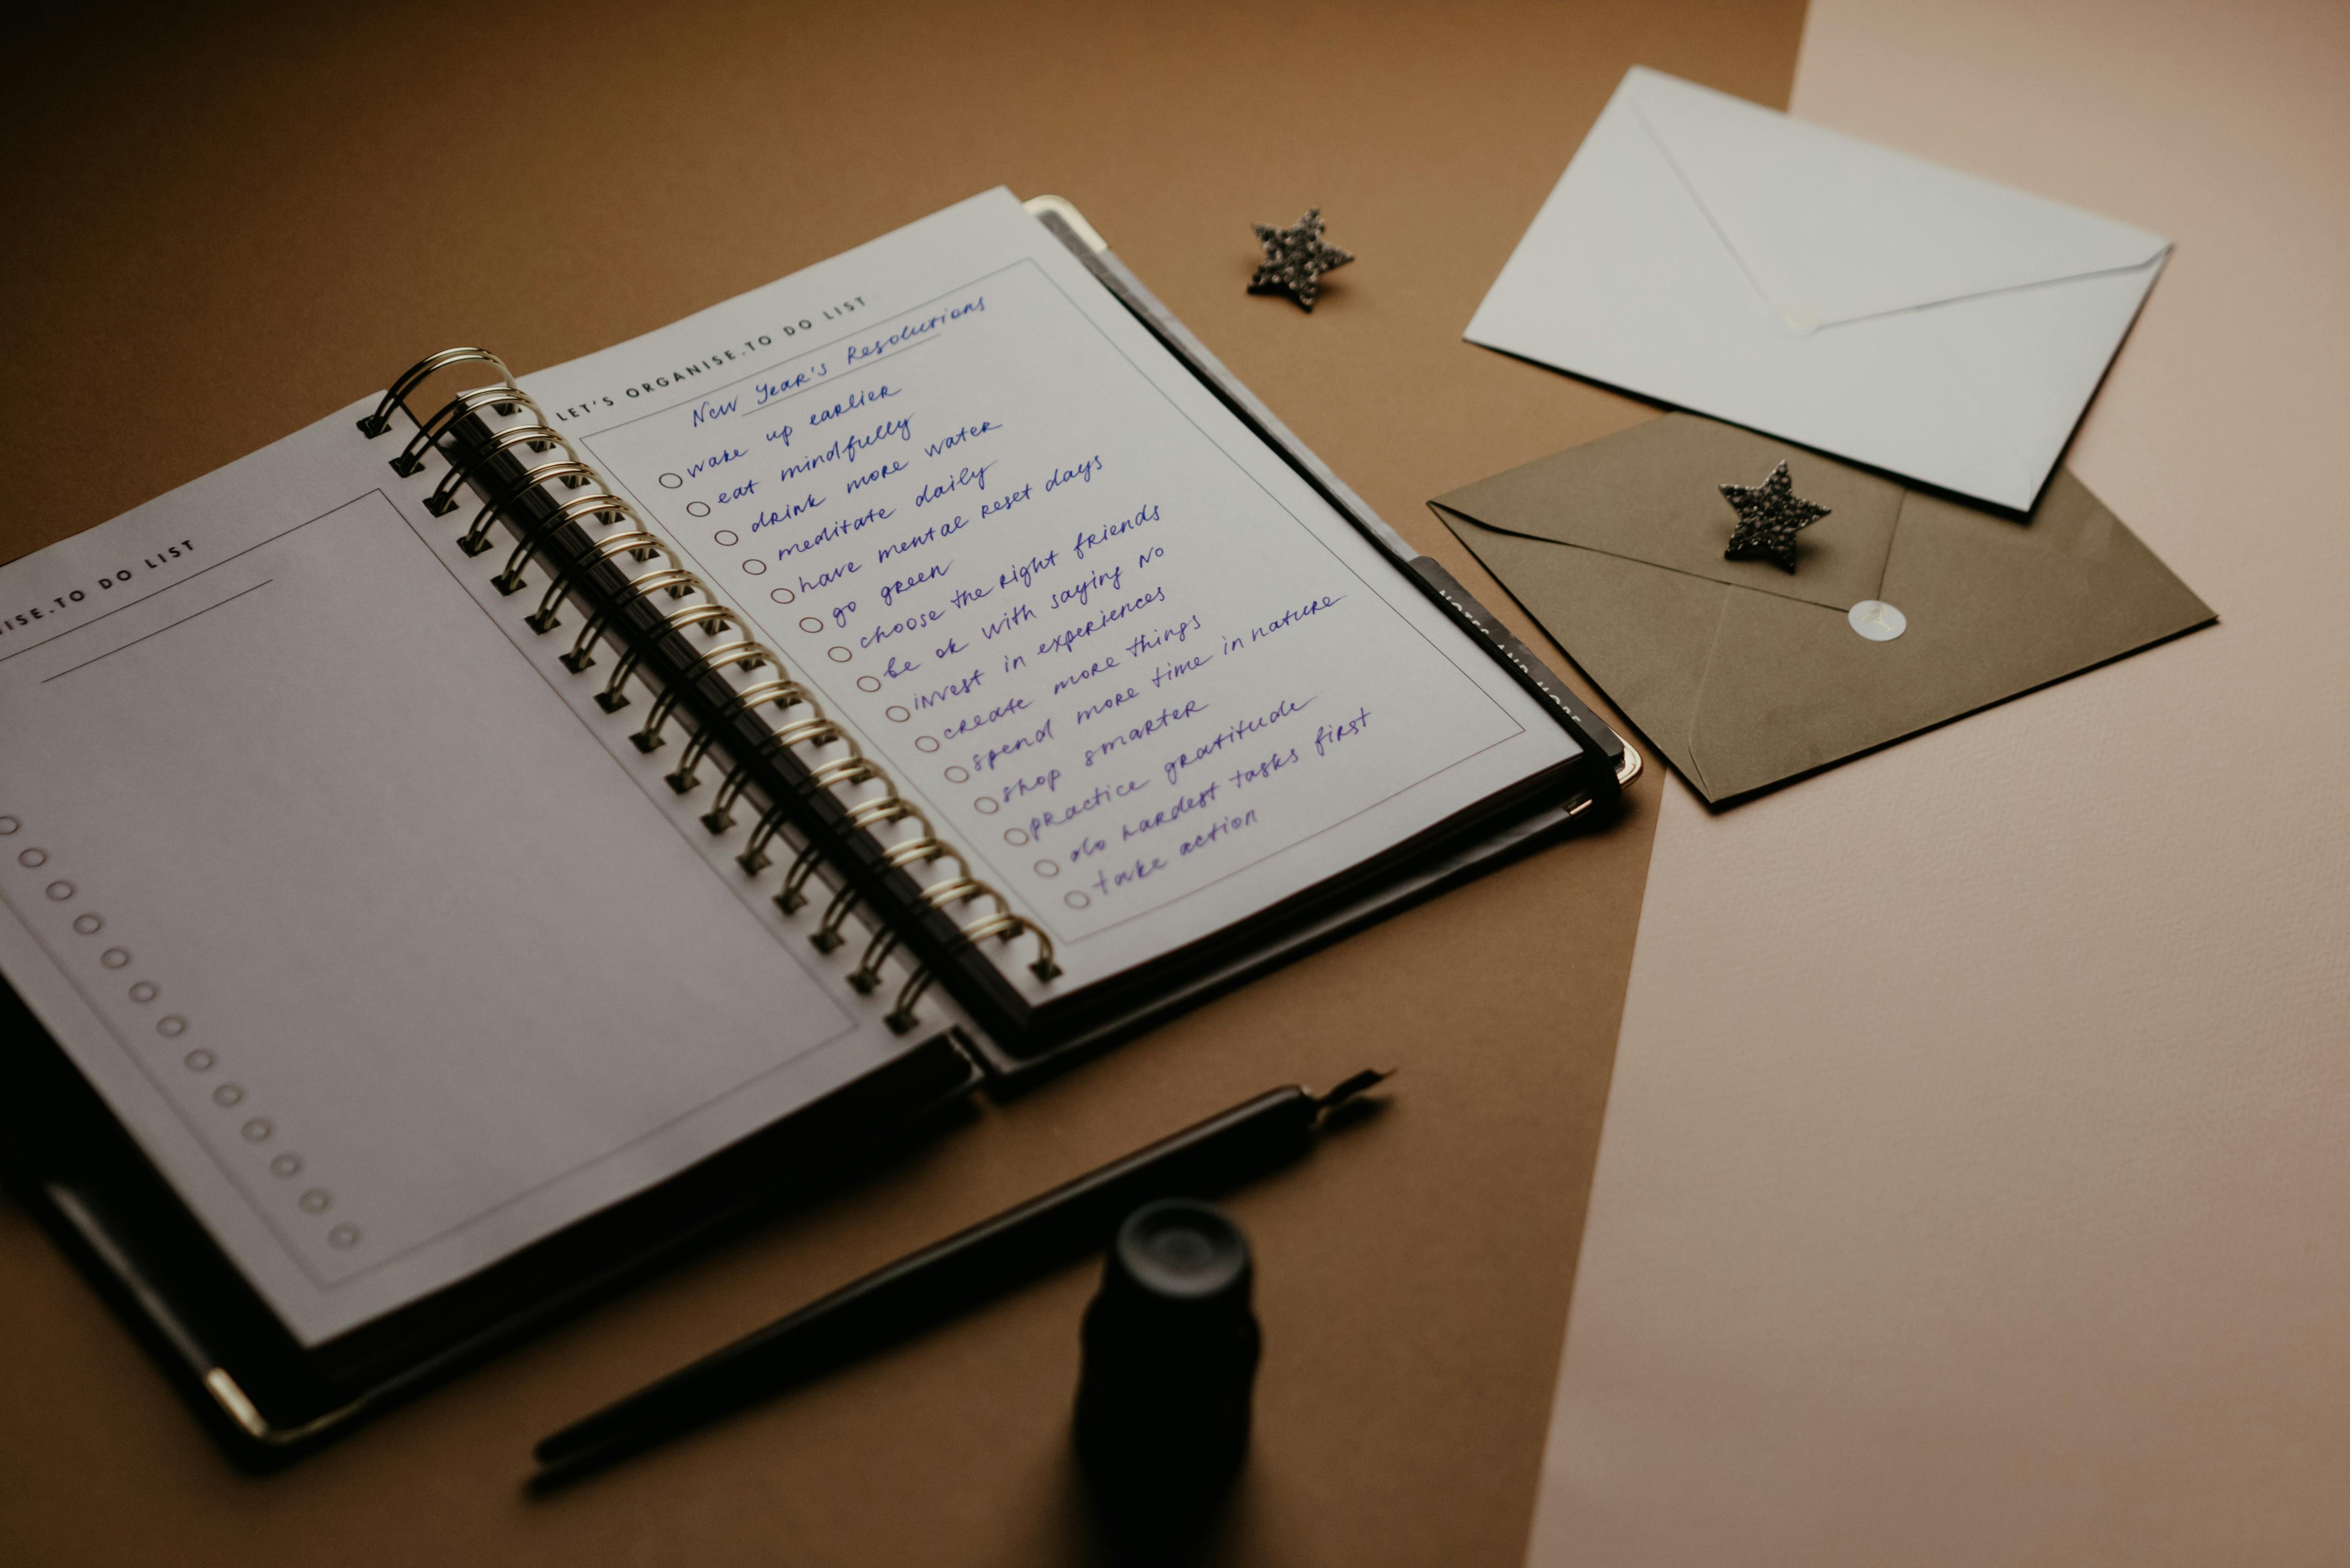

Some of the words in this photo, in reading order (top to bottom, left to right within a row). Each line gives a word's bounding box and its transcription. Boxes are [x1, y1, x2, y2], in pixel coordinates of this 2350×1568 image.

[556, 397, 614, 422] LET'S
[783, 319, 812, 336] DO
[823, 296, 865, 320] LIST
[692, 397, 738, 428] New
[847, 296, 985, 365] Resolutions
[686, 449, 748, 478] wake
[766, 425, 793, 447] up
[809, 385, 901, 426] earlier
[717, 479, 760, 504] eat
[780, 414, 912, 482] mindfully
[751, 493, 826, 533] drink
[846, 461, 909, 494] more
[924, 421, 1003, 458] water
[97, 570, 133, 590] DO
[144, 539, 194, 569] LIST
[778, 508, 897, 561] meditate
[915, 461, 997, 508] daily
[798, 561, 862, 593] have
[878, 515, 969, 564] mental
[1045, 454, 1103, 492] days
[832, 601, 857, 628] go
[880, 561, 952, 606] green
[860, 610, 945, 649] choose
[950, 586, 994, 609] the
[1073, 504, 1160, 560] friends
[883, 656, 922, 679] be
[935, 638, 970, 659] ok
[981, 604, 1037, 640] with
[1051, 565, 1122, 609] saying
[1004, 655, 1027, 673] in
[1036, 586, 1165, 655] experiences
[943, 698, 1032, 740] create
[1054, 657, 1121, 695] more
[1125, 614, 1201, 658] things
[972, 718, 1054, 772] spend
[1077, 687, 1139, 725] more
[1151, 656, 1212, 688] time
[1222, 636, 1244, 656] in
[1251, 595, 1346, 642] nature
[1003, 769, 1061, 803] shop
[1084, 700, 1209, 767] smarter
[1029, 780, 1150, 842] practice
[1164, 696, 1317, 786] gratitude
[1228, 748, 1299, 789] tasks
[1314, 707, 1371, 757] first
[1092, 858, 1167, 896] take
[1179, 810, 1257, 857] action
